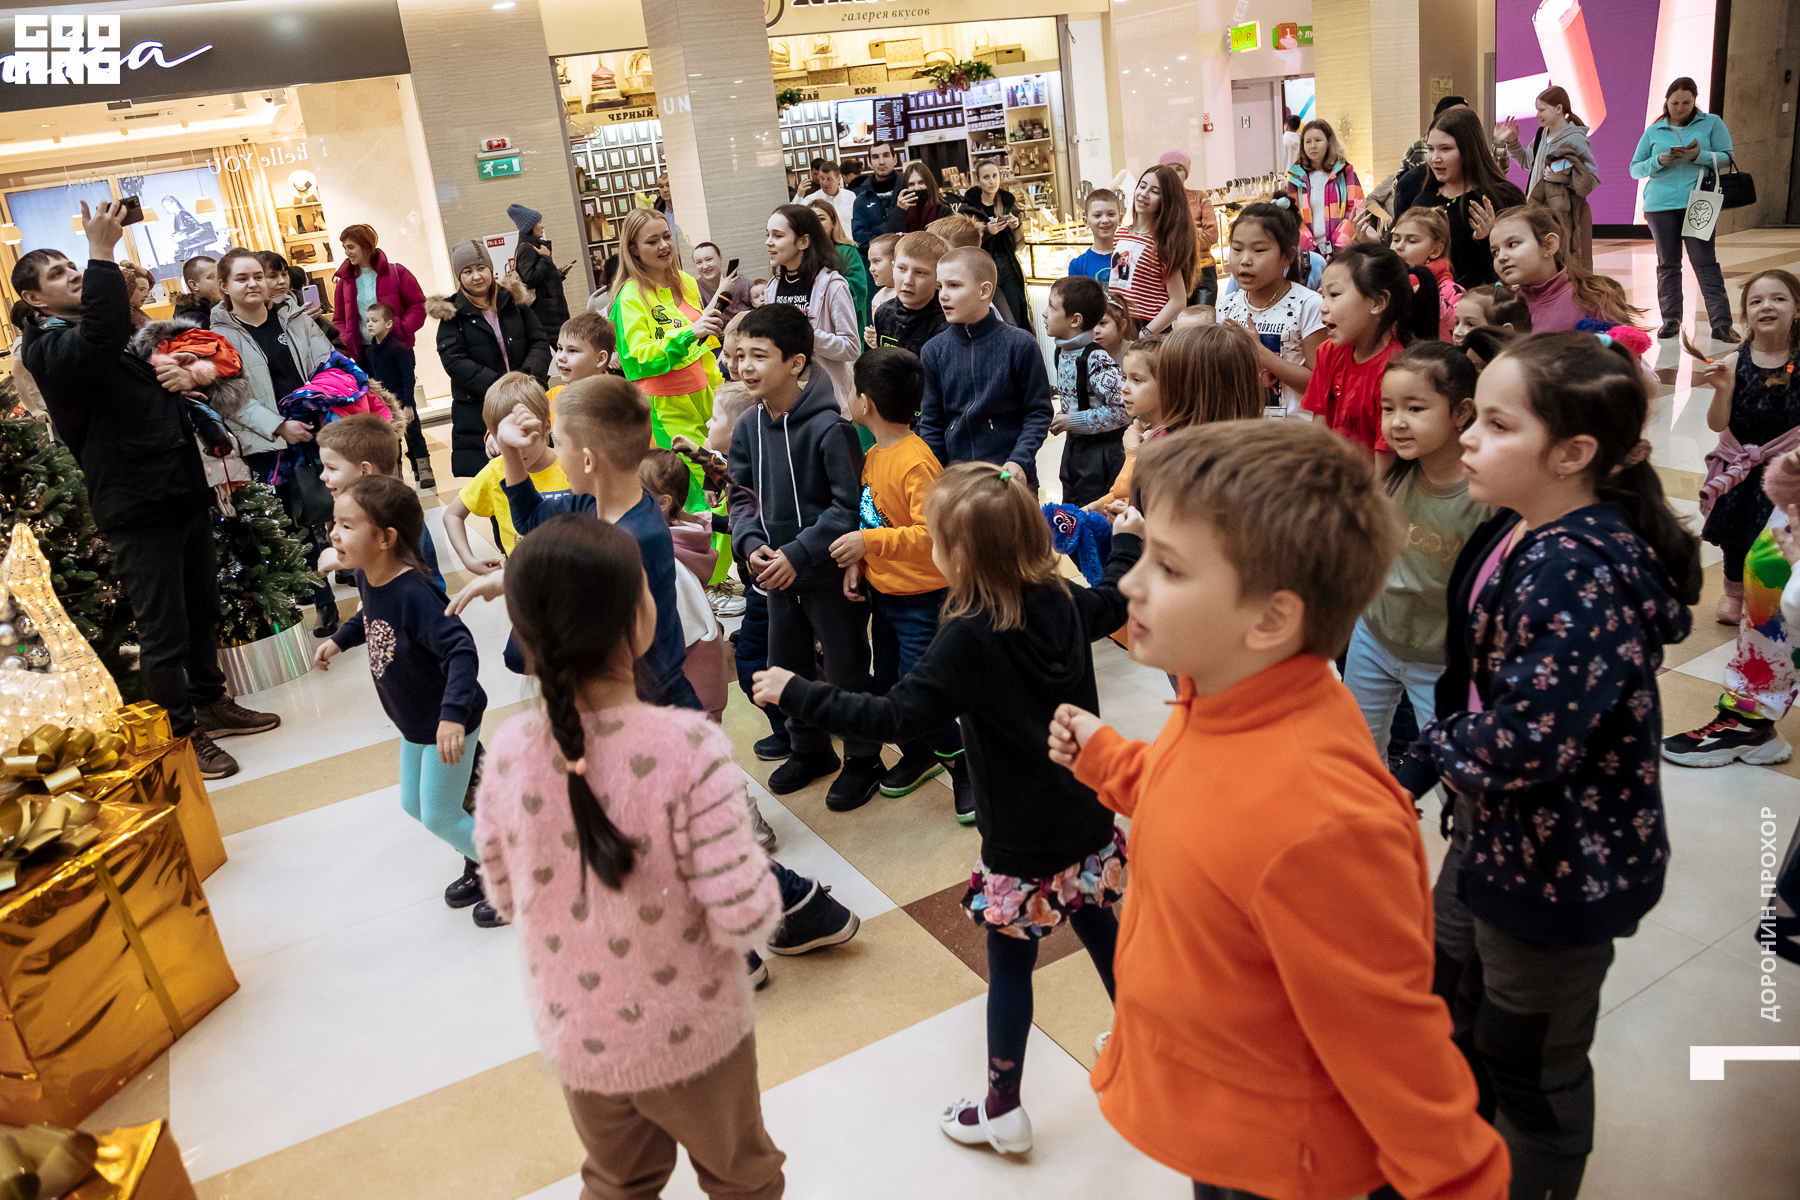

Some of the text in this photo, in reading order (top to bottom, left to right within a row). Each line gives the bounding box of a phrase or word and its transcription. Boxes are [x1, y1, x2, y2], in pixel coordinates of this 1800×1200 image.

[842, 7, 931, 22] галерея вкусов
[854, 86, 877, 96] КОФЕ
[608, 107, 654, 121] ЧЕРНЫЙ
